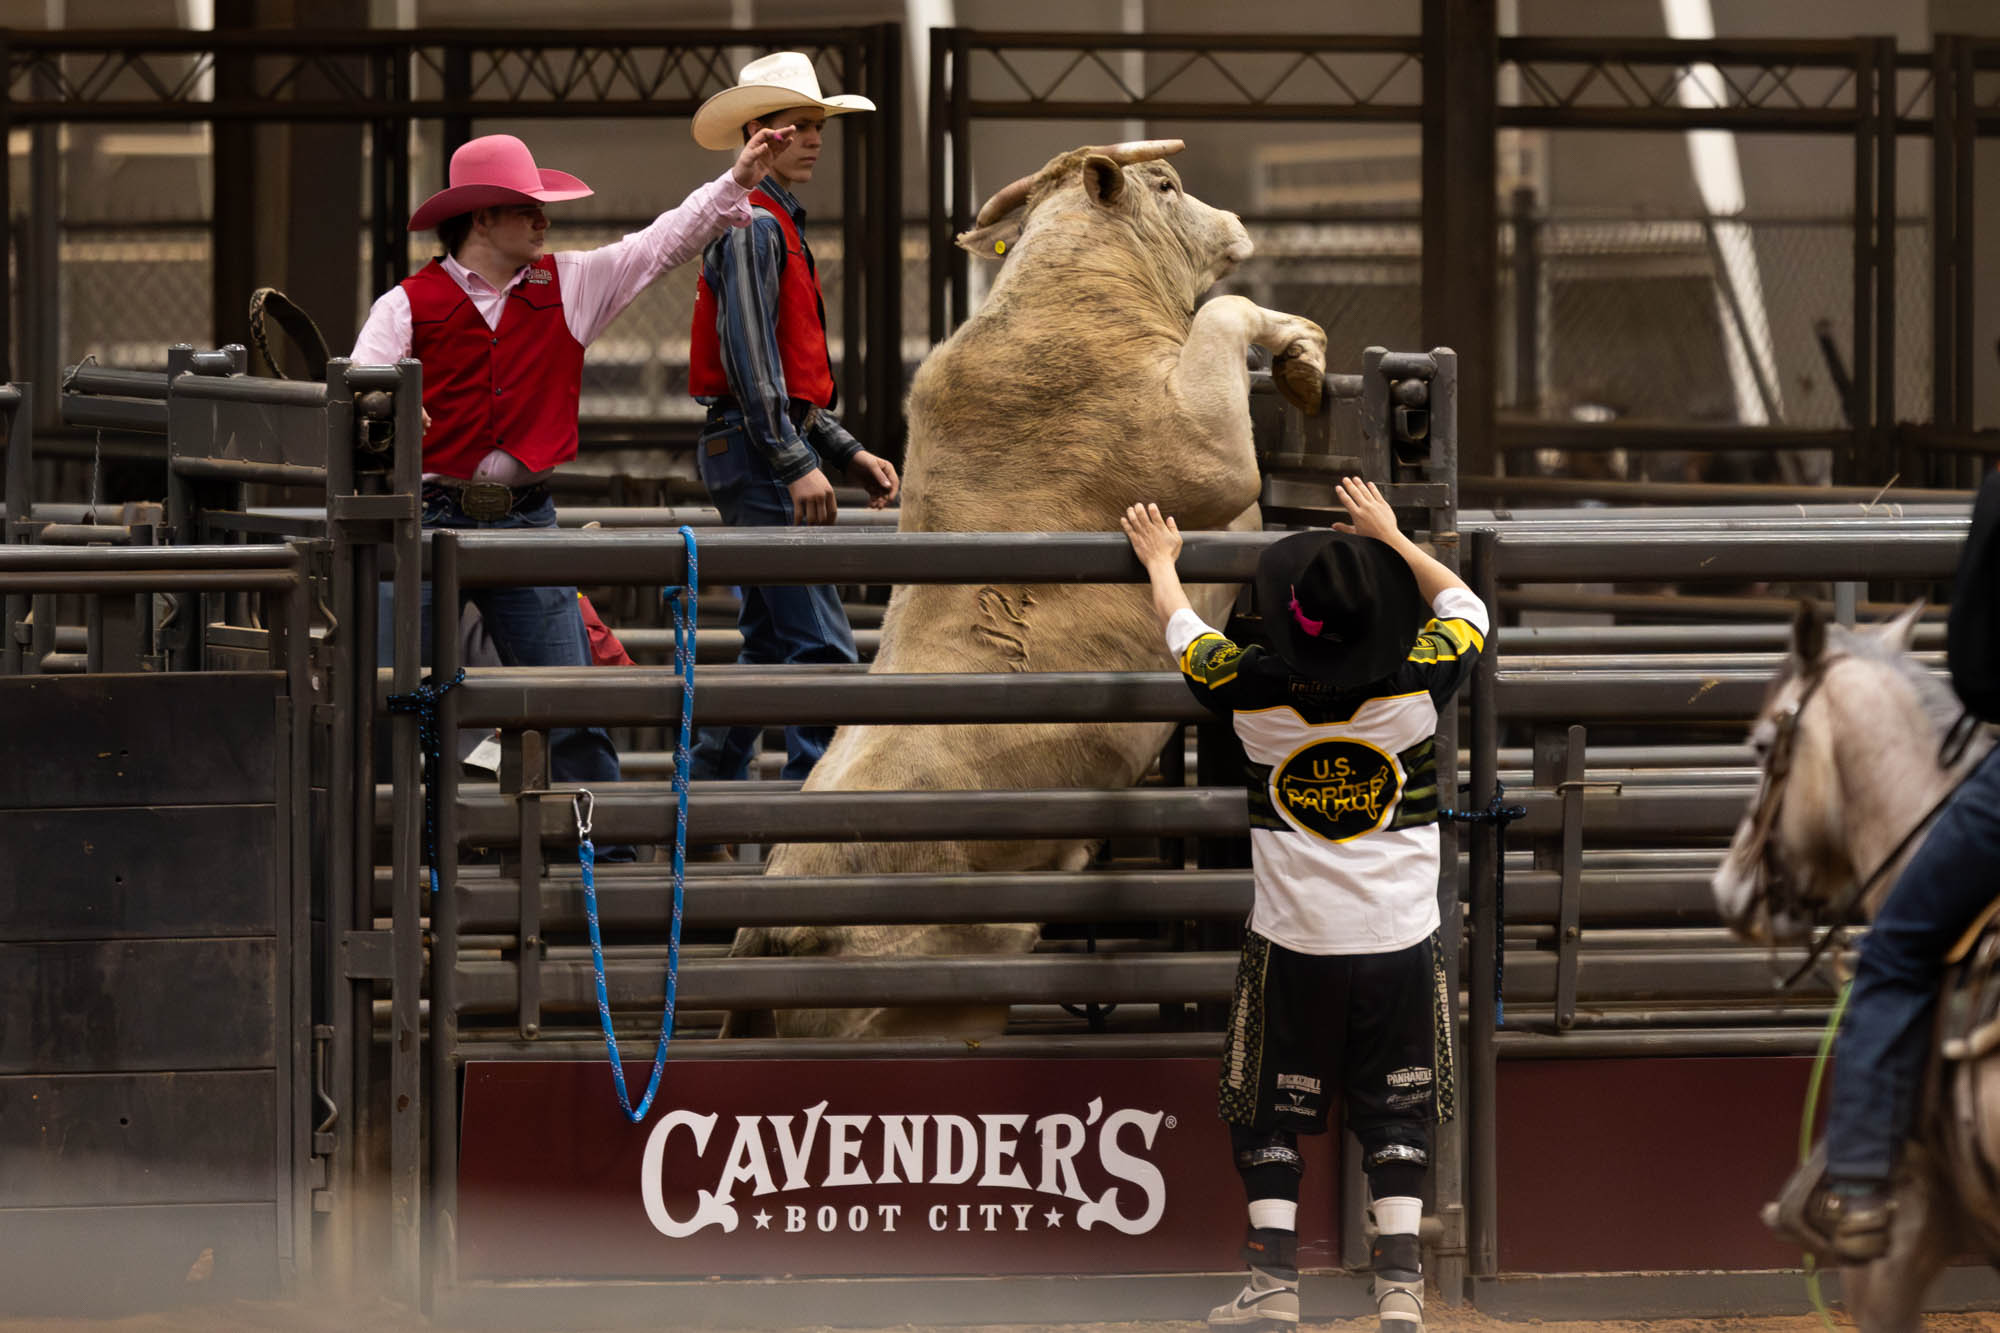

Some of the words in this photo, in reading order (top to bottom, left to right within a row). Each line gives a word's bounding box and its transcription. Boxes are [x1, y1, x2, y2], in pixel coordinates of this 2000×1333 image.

[1313, 757, 1357, 779] U.S.
[1386, 1069, 1433, 1086] PANHANDLE
[784, 1204, 901, 1233] BOOT
[928, 1204, 1034, 1232] CITY
